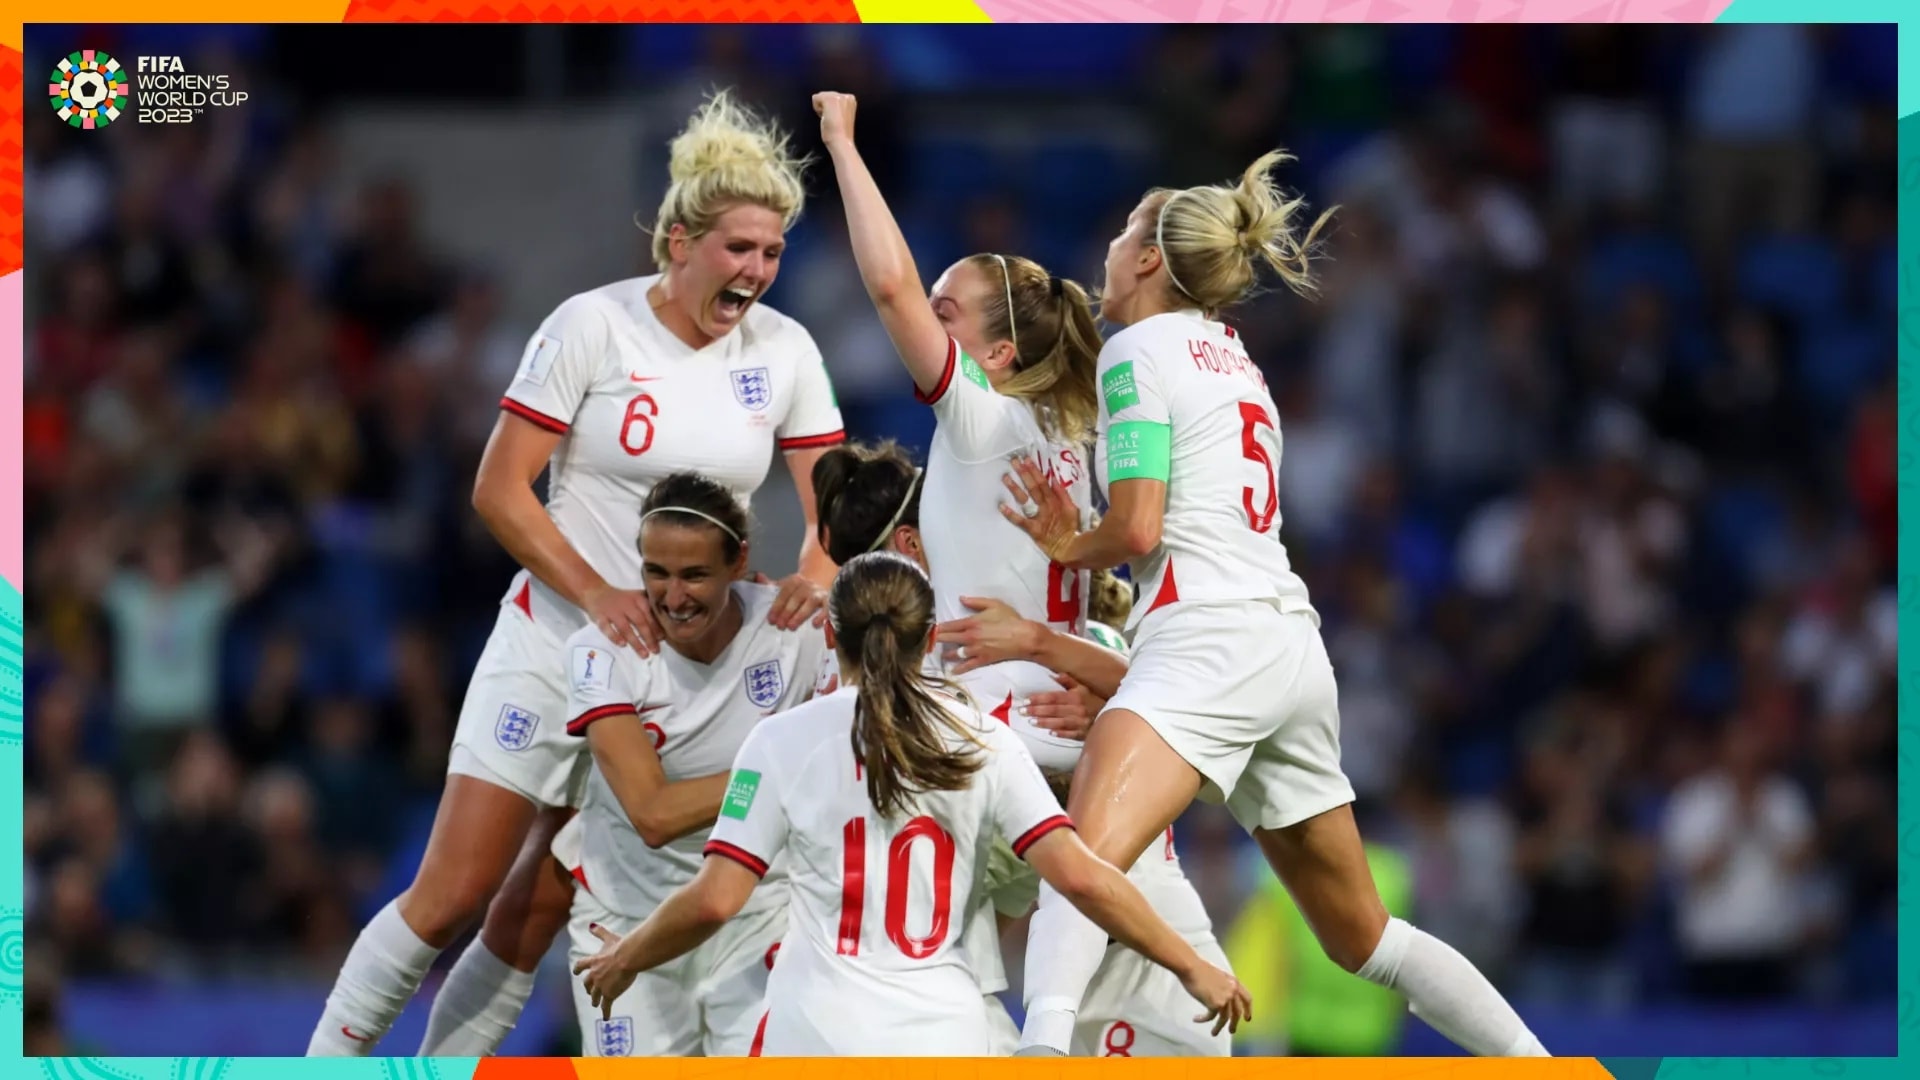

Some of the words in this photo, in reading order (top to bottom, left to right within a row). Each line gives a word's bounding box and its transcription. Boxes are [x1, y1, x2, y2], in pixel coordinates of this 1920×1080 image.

[618, 393, 659, 457] 6
[1113, 457, 1139, 471] FIFA
[1237, 400, 1278, 535] 5
[836, 815, 956, 960] 10
[1105, 1020, 1136, 1057] 8
